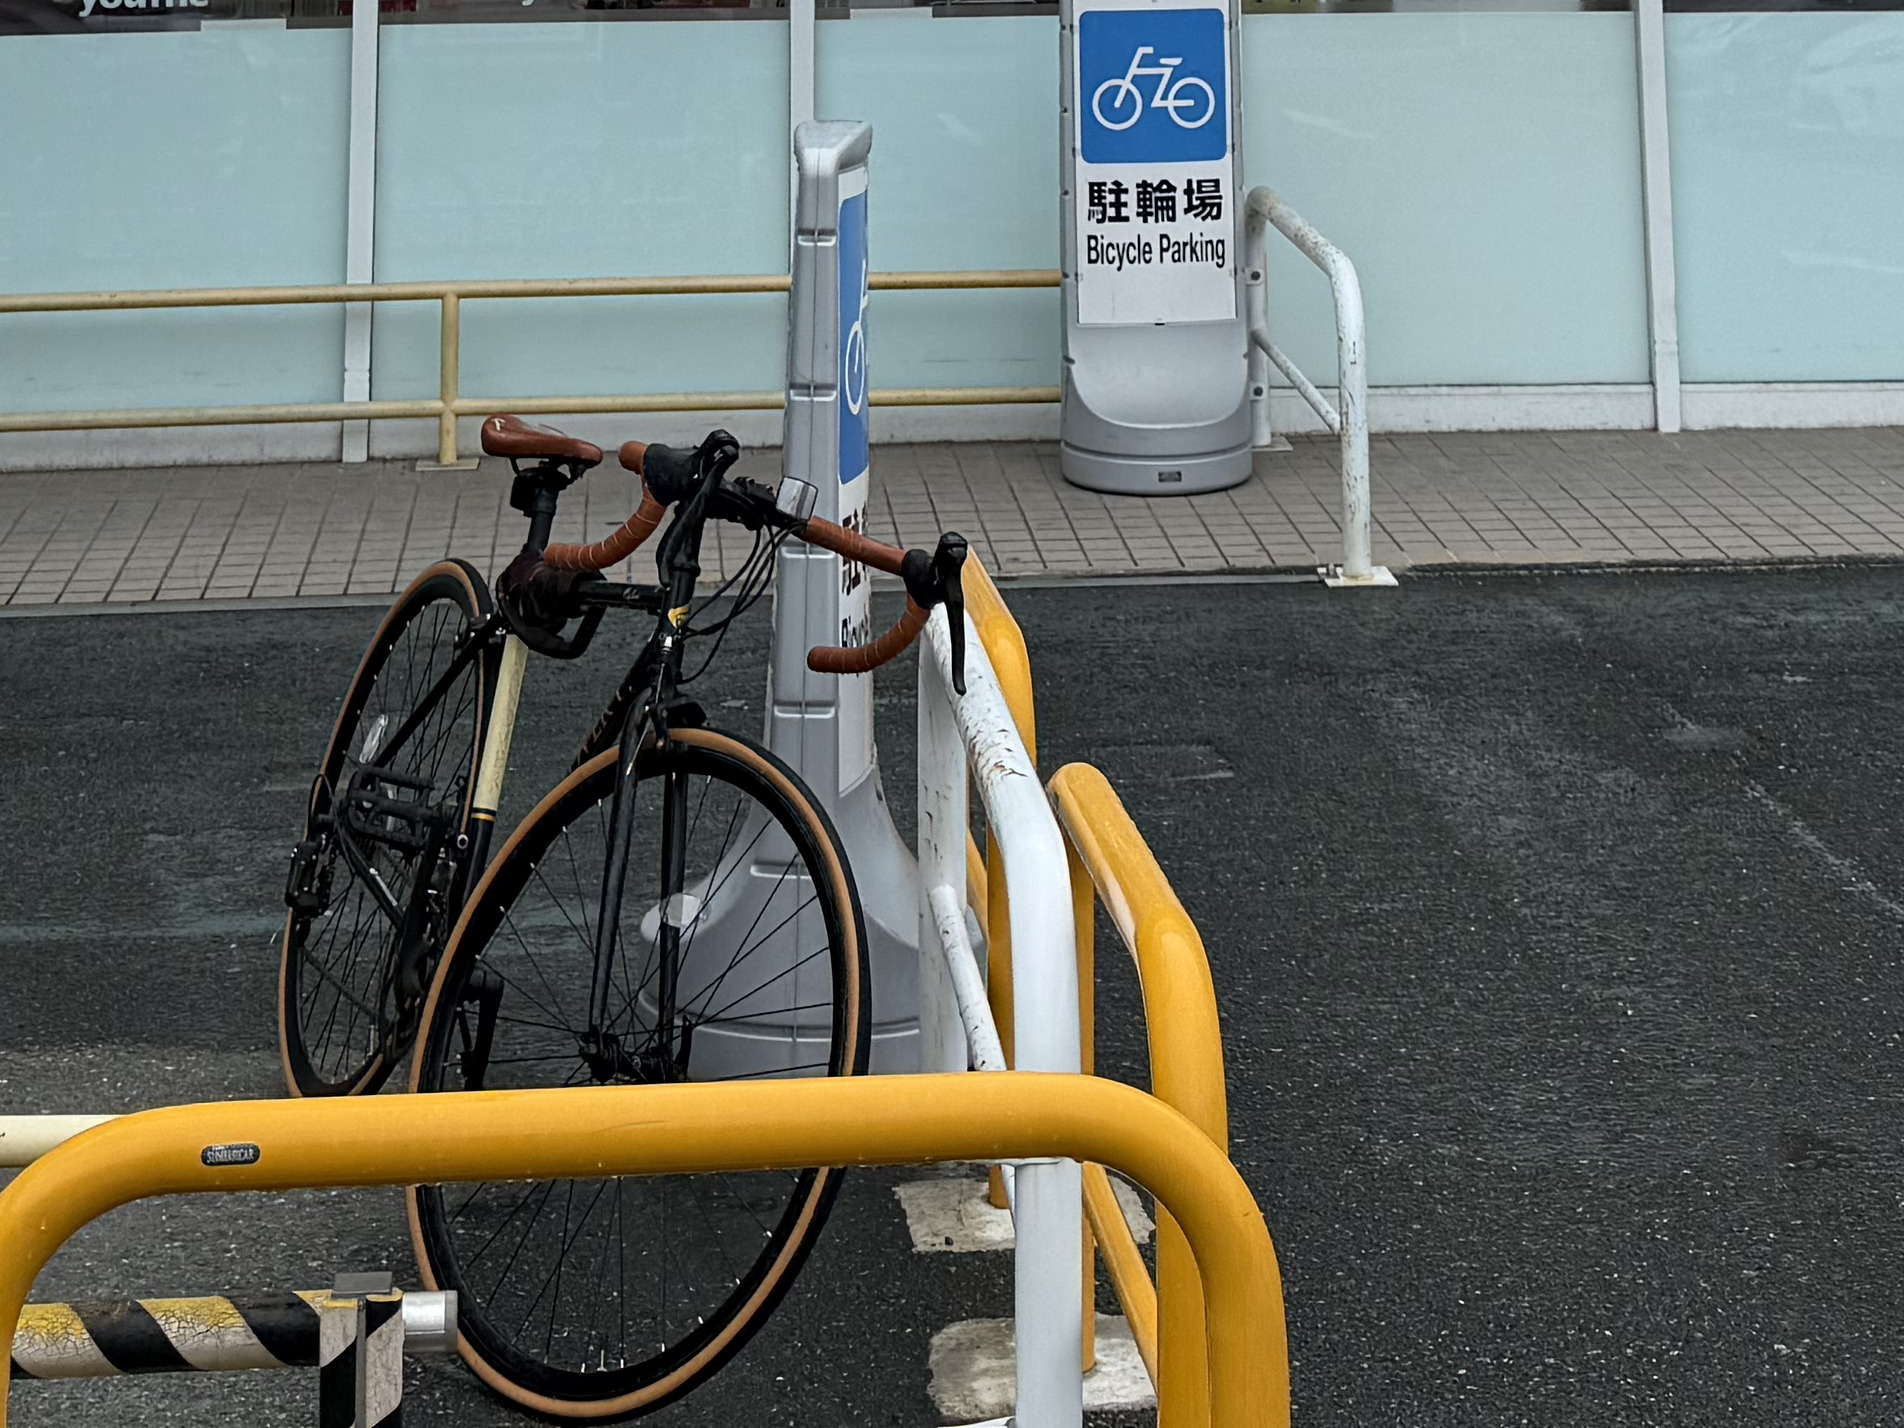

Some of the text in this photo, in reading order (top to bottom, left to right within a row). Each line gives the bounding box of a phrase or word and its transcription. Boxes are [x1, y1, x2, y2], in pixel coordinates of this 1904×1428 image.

[1087, 178, 1224, 224] 駐輪場
[1086, 231, 1226, 273] Bicycle Parking
